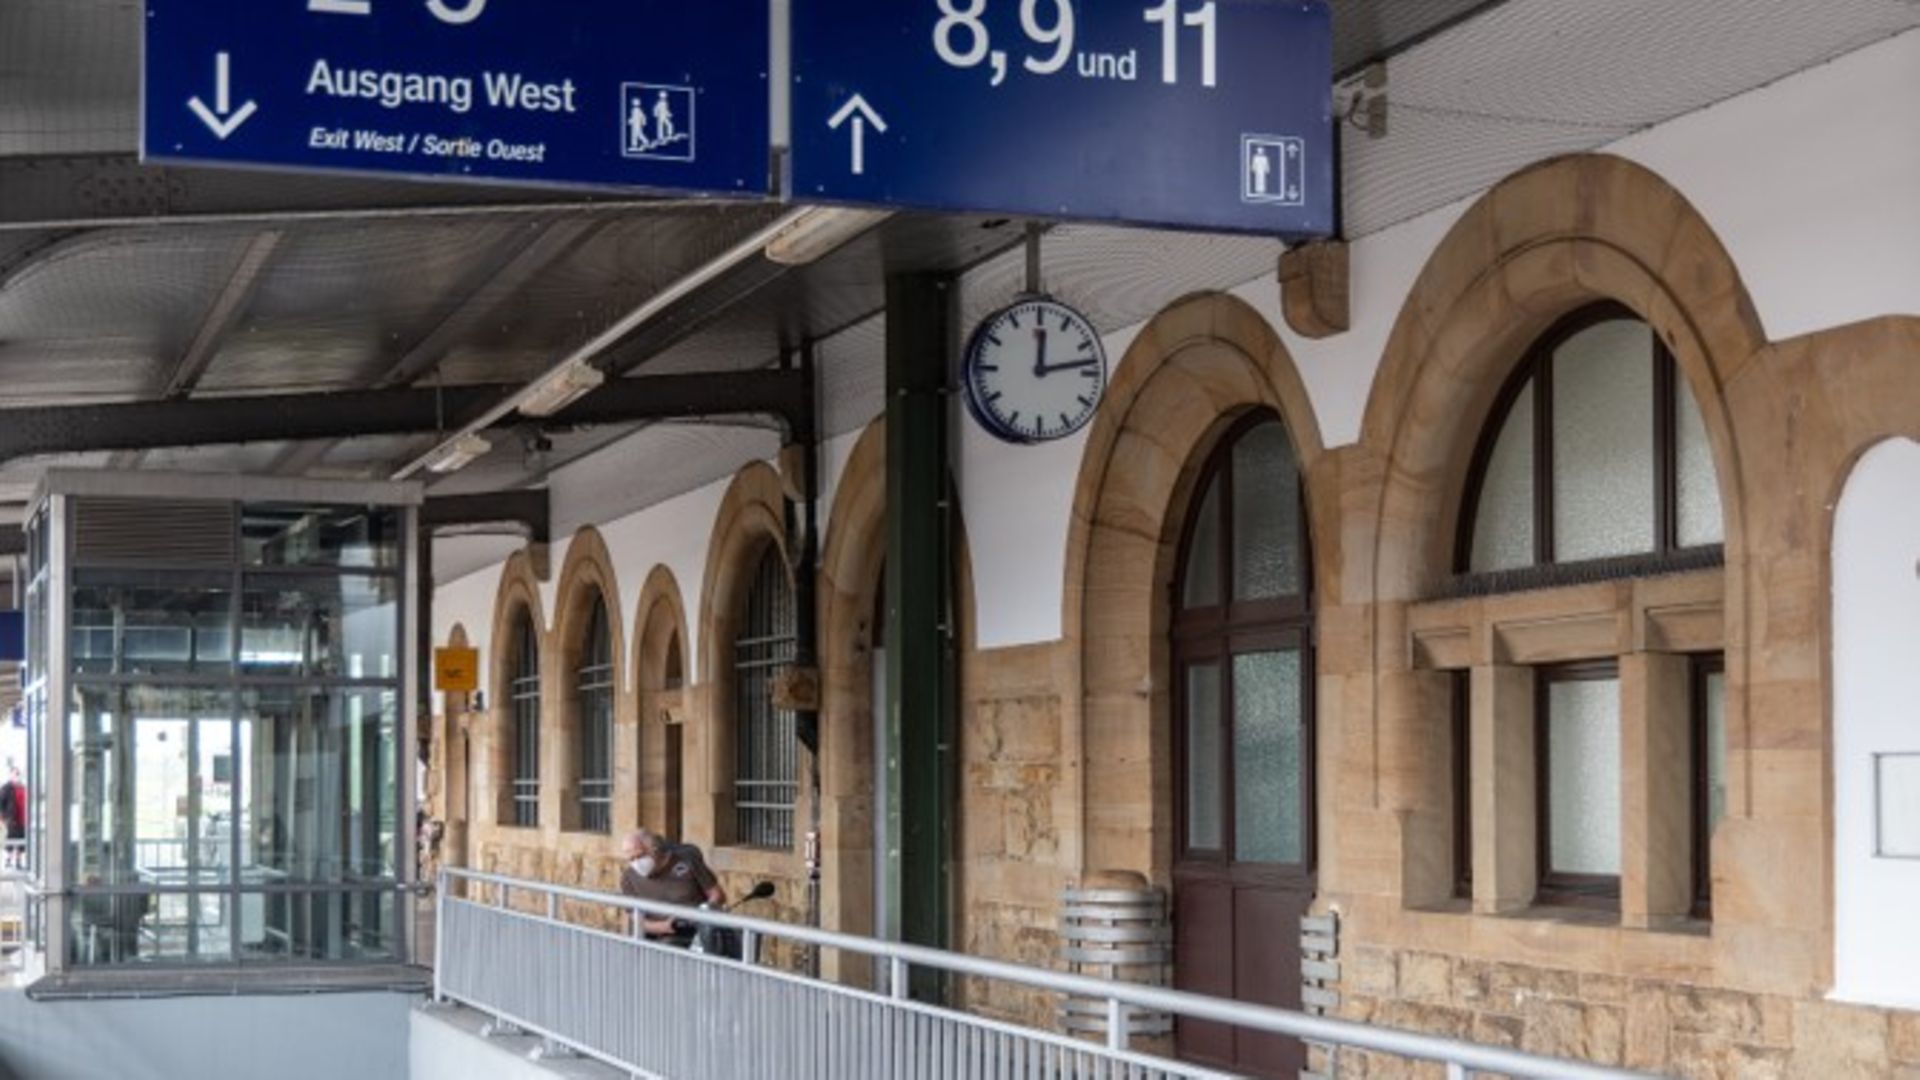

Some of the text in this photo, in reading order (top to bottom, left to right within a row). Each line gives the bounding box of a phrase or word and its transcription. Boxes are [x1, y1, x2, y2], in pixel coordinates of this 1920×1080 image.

[1077, 49, 1137, 80] und
[1143, 0, 1217, 87] 11
[306, 58, 576, 112] Ausgang West
[309, 126, 546, 162] Exit West / Sortie Ouest
